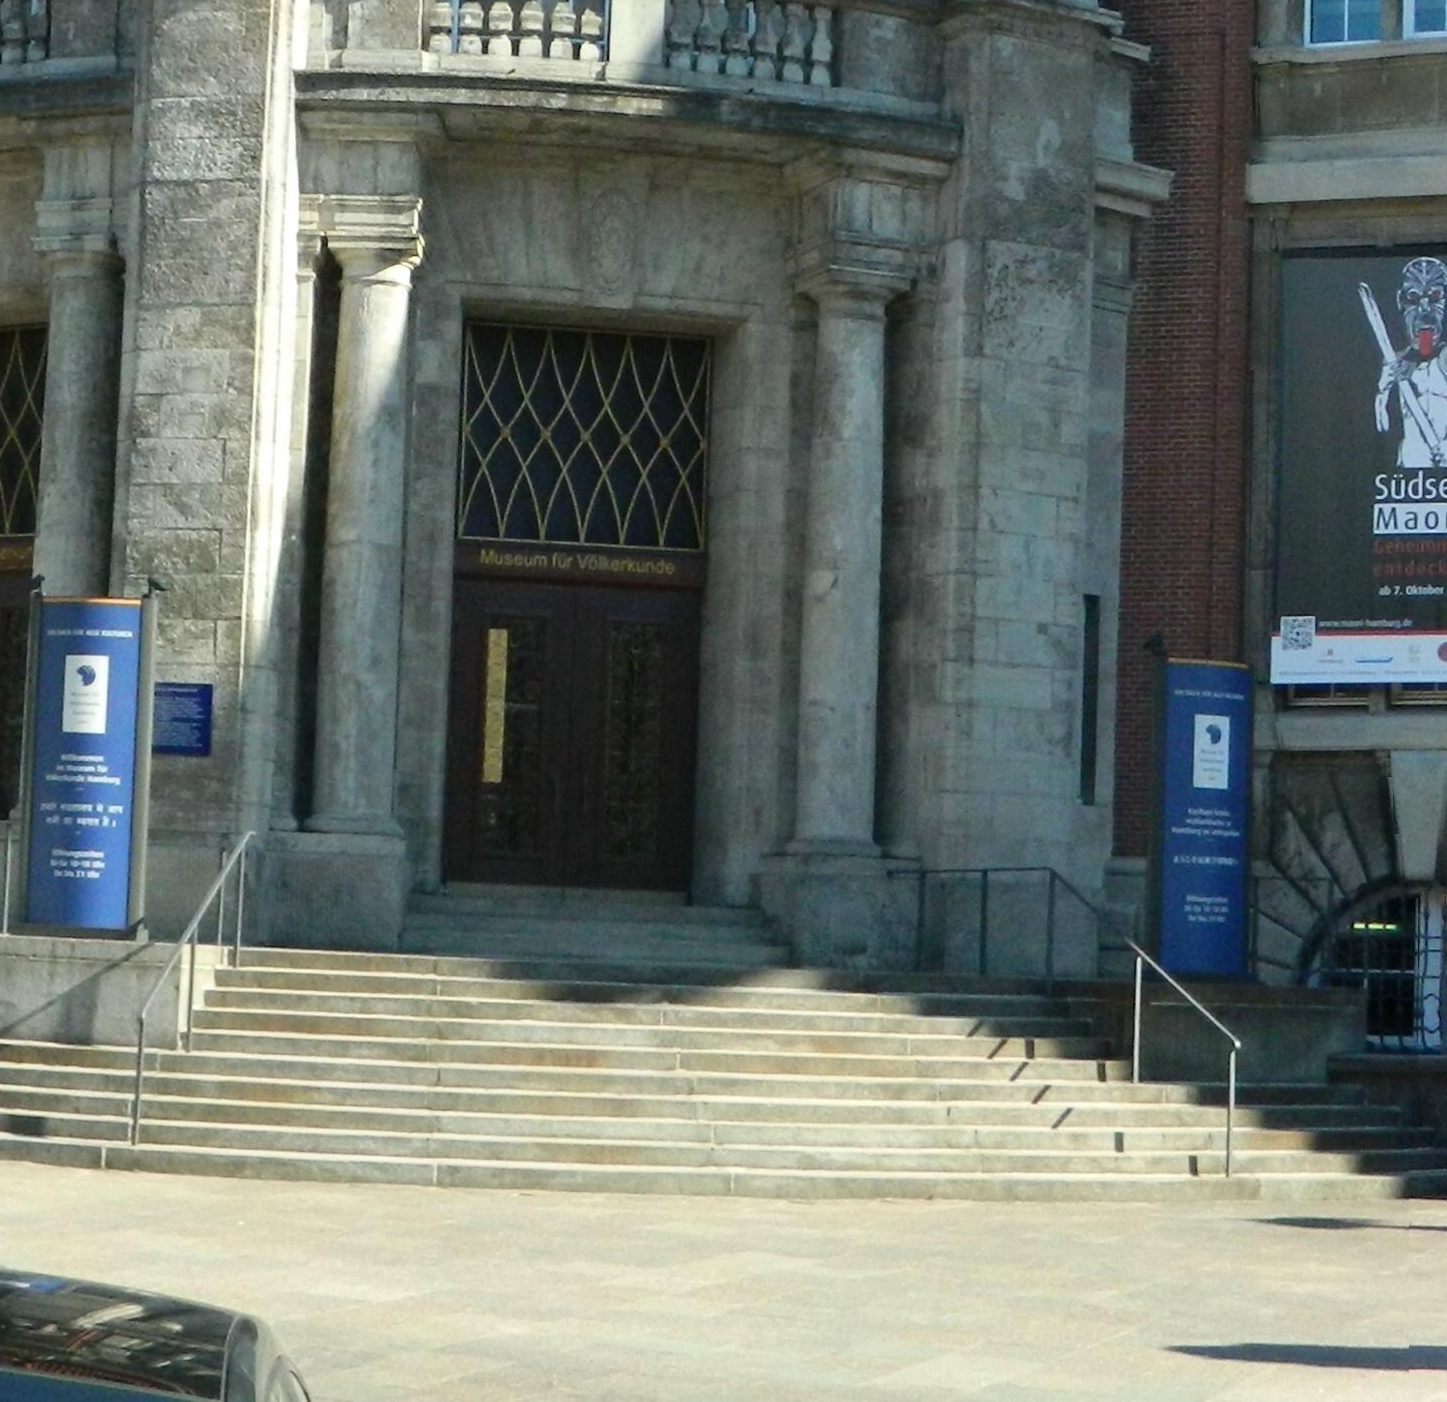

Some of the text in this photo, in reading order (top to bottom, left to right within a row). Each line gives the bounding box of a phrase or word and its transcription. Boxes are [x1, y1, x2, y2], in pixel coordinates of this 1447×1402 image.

[479, 549, 675, 575] Museum für Völkerkunde
[1379, 585, 1392, 595] ab
[1394, 585, 1403, 595] 7.
[1406, 584, 1444, 595] Oktober
